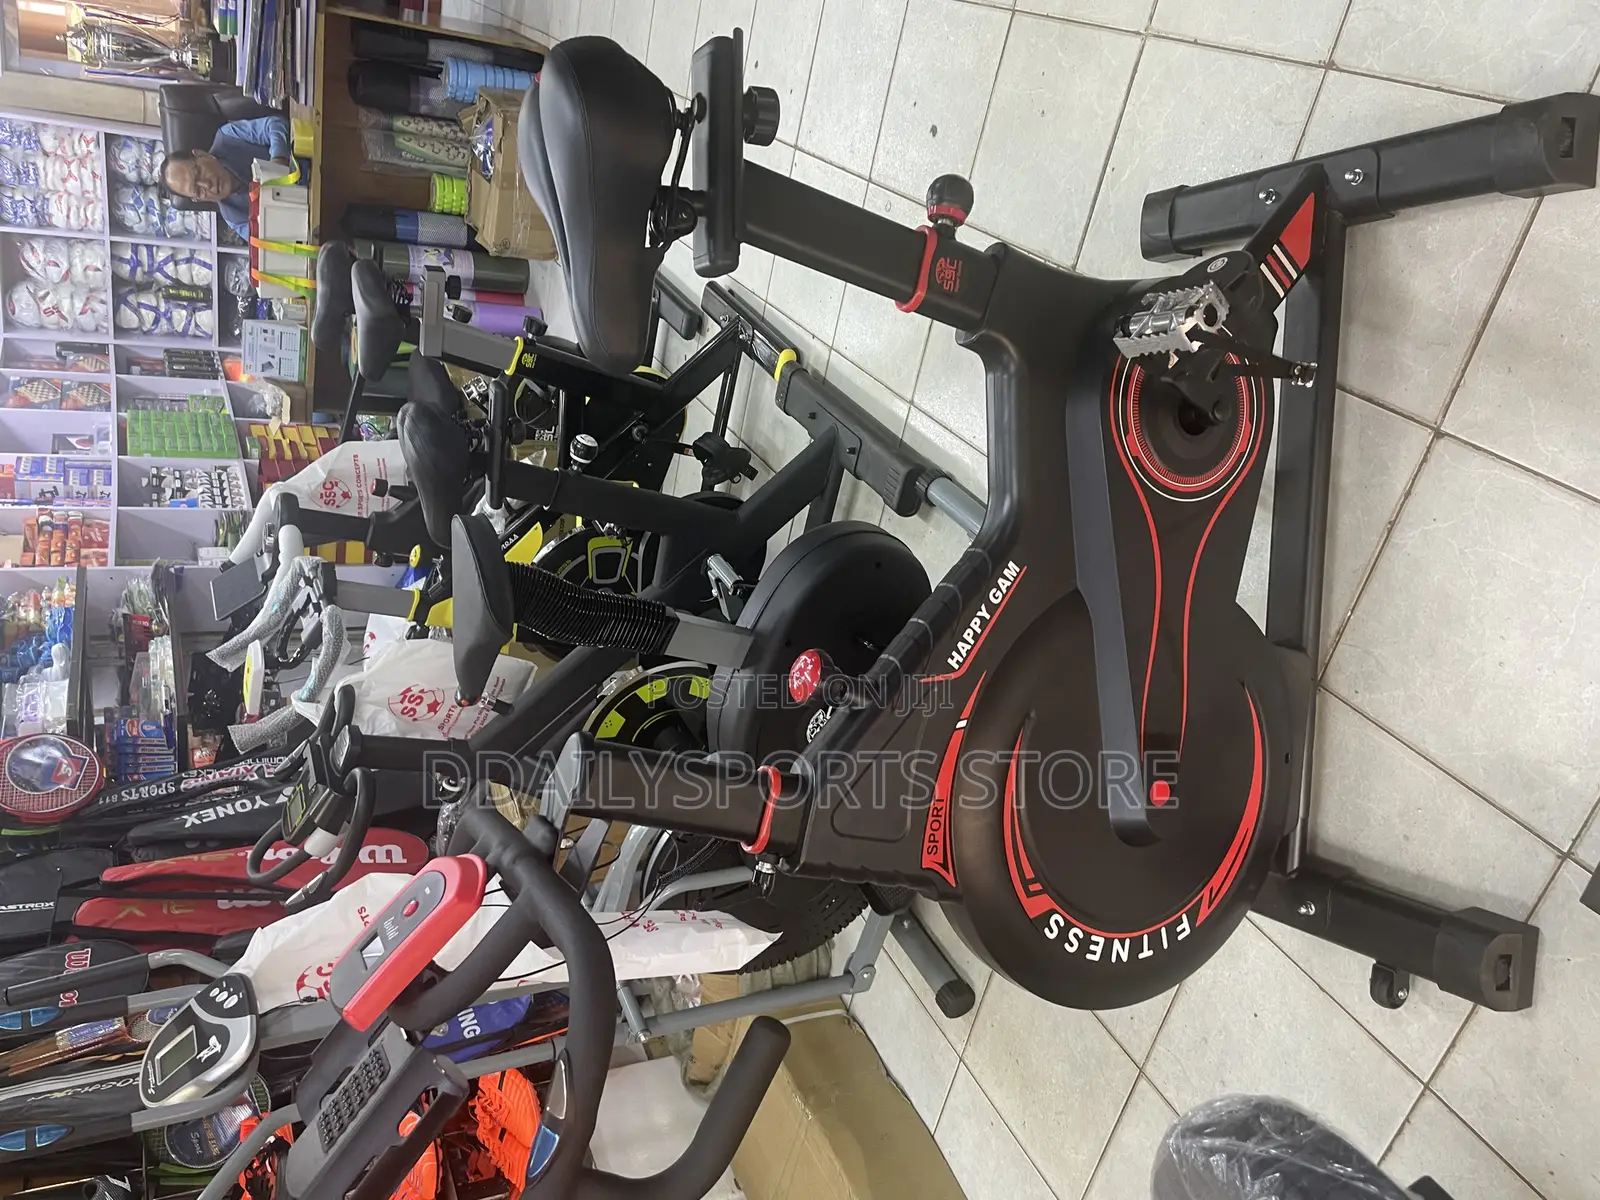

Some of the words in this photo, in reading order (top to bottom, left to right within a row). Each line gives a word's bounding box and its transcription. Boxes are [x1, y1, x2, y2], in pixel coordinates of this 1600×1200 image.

[947, 603, 991, 670] HAPPY
[988, 560, 1020, 604] GAM
[121, 781, 176, 802] SPORTS
[184, 794, 269, 827] YONEX
[926, 793, 946, 855] SPORT
[1043, 913, 1191, 963] FITNESS
